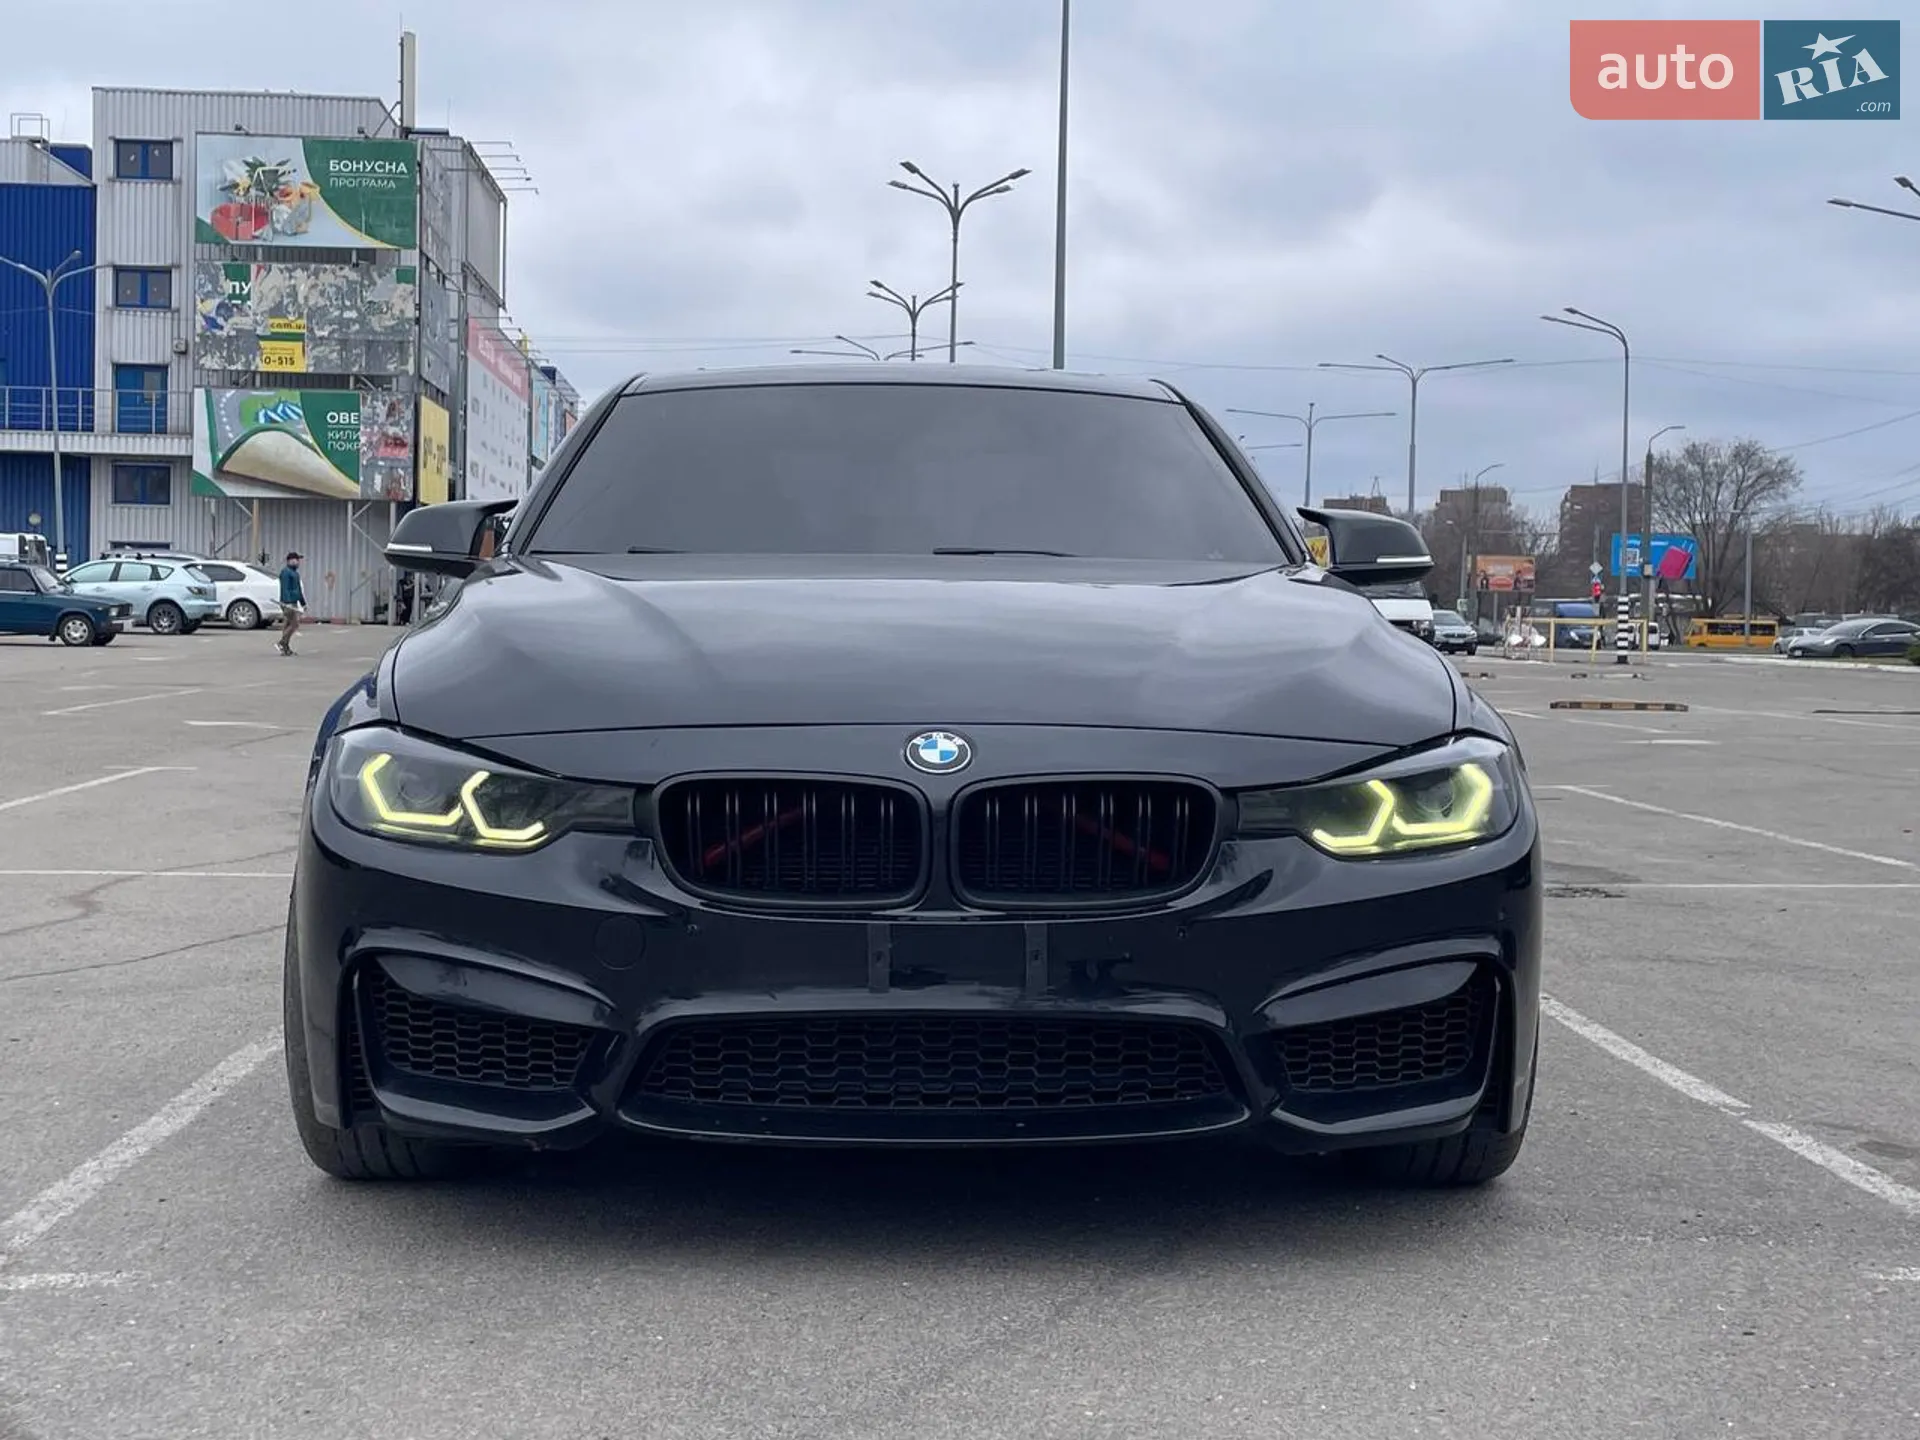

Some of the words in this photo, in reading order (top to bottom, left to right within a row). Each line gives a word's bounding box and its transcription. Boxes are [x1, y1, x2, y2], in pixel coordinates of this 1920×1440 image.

[329, 160, 408, 174] БОНУСНА
[329, 177, 396, 189] ПРОГРАМА
[230, 281, 251, 294] ПУ
[261, 356, 295, 366] 0-515
[326, 411, 359, 424] ОВЕ
